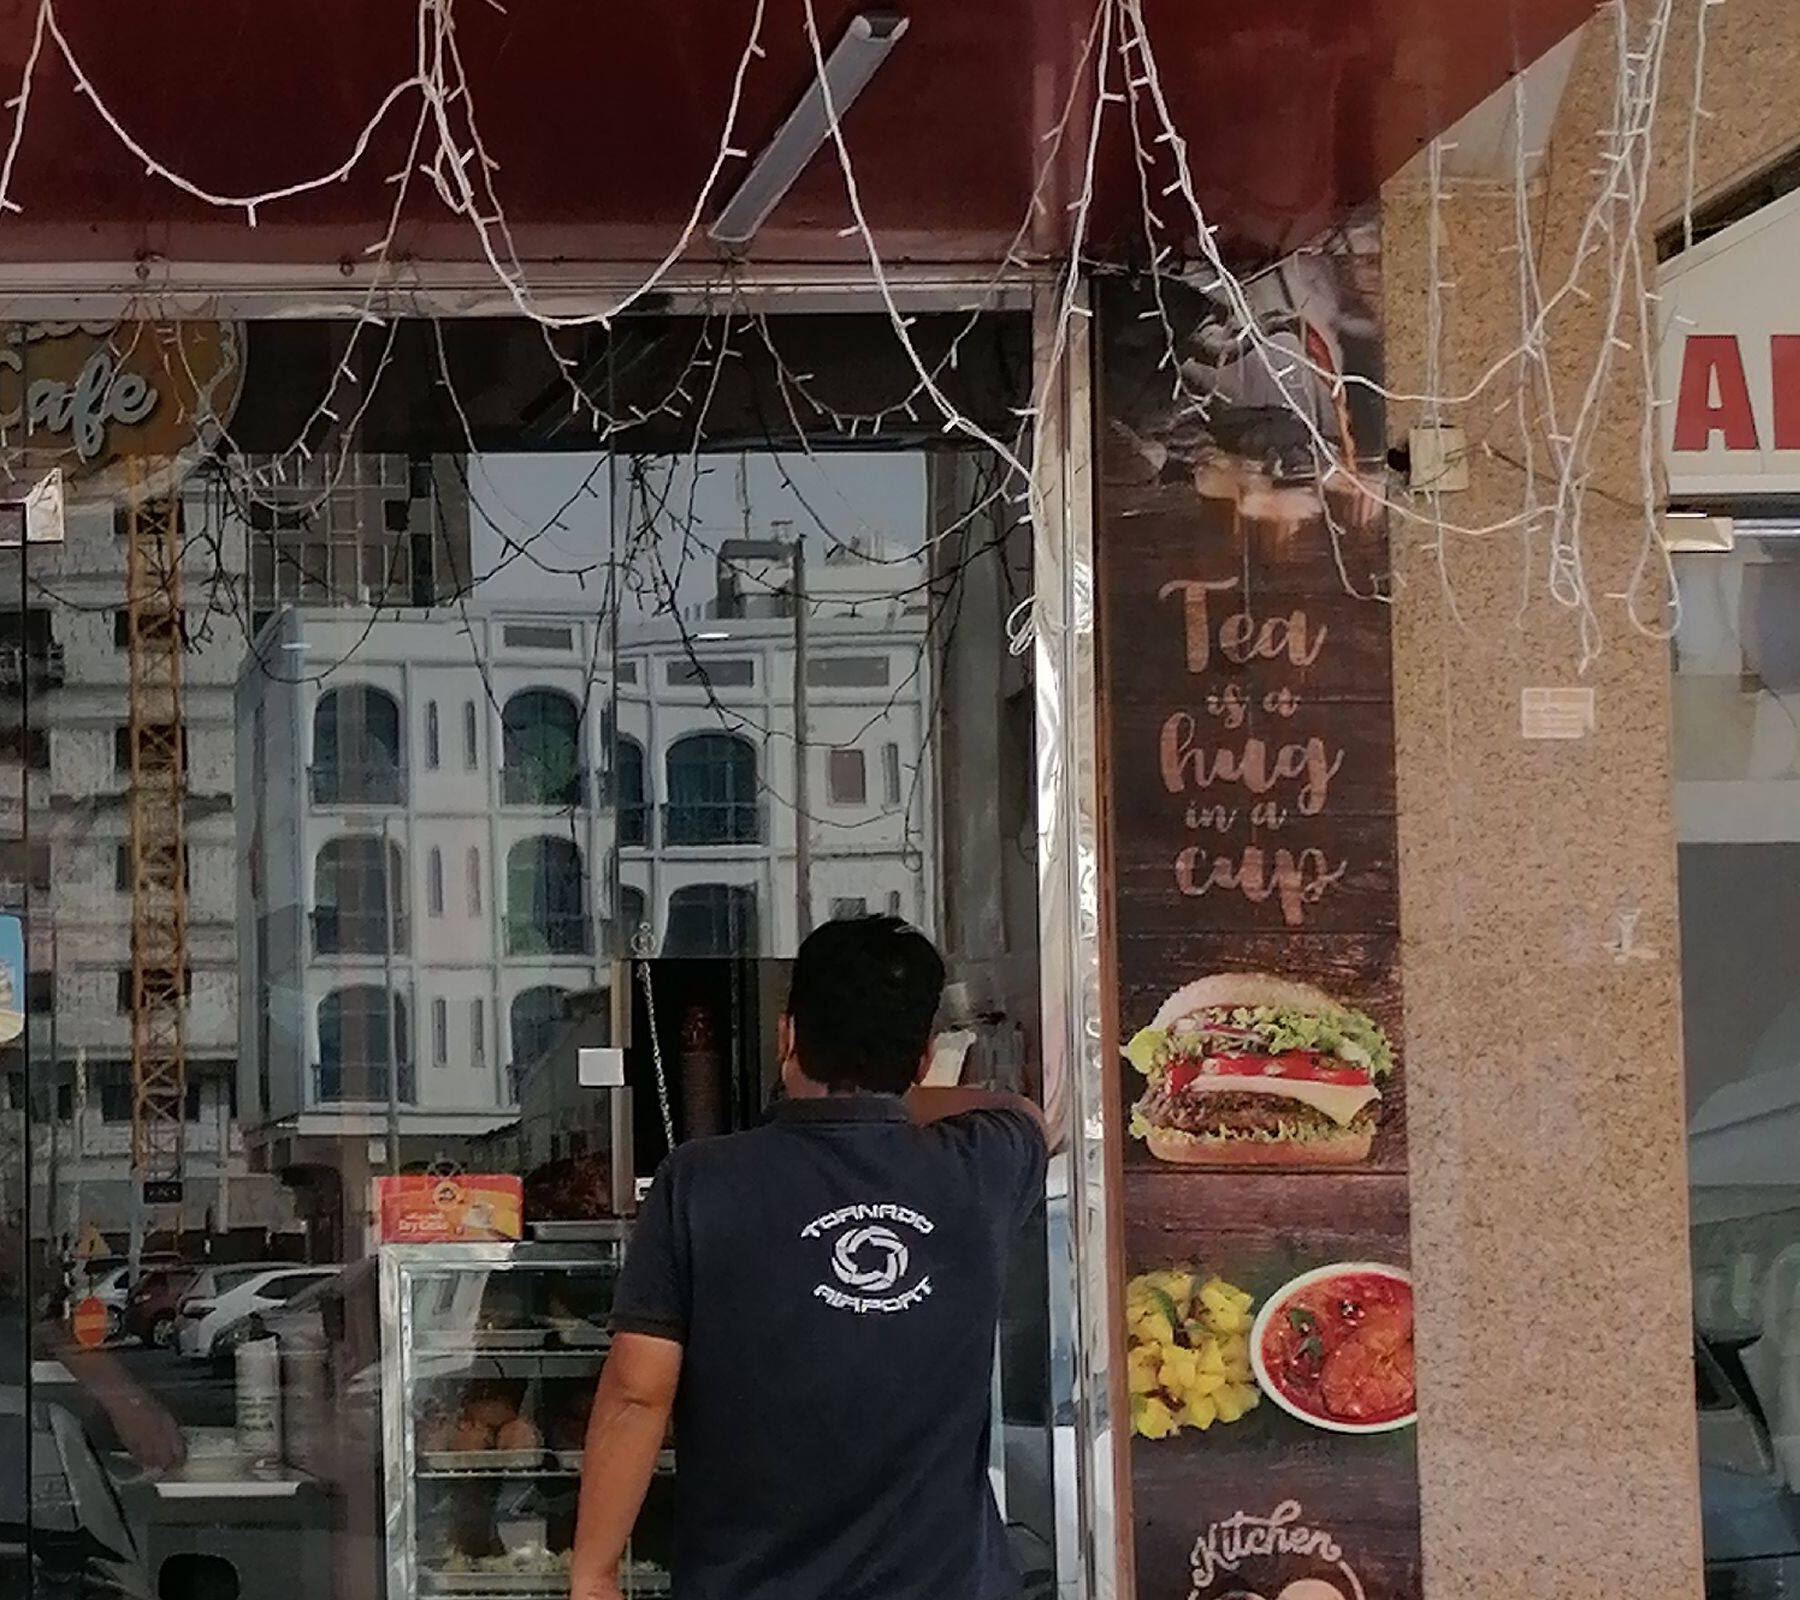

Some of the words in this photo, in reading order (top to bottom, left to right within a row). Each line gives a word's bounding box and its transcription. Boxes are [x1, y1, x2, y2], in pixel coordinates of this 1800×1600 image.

[1159, 576, 1328, 674] Tea
[1207, 684, 1249, 729] is
[1262, 687, 1300, 718] a
[1160, 712, 1345, 815] hug
[1185, 802, 1238, 833] in
[1251, 801, 1288, 831] a
[800, 1203, 935, 1238] TORNADO
[812, 1275, 933, 1314] AIRPORT
[1190, 1499, 1343, 1588] Kitchen
